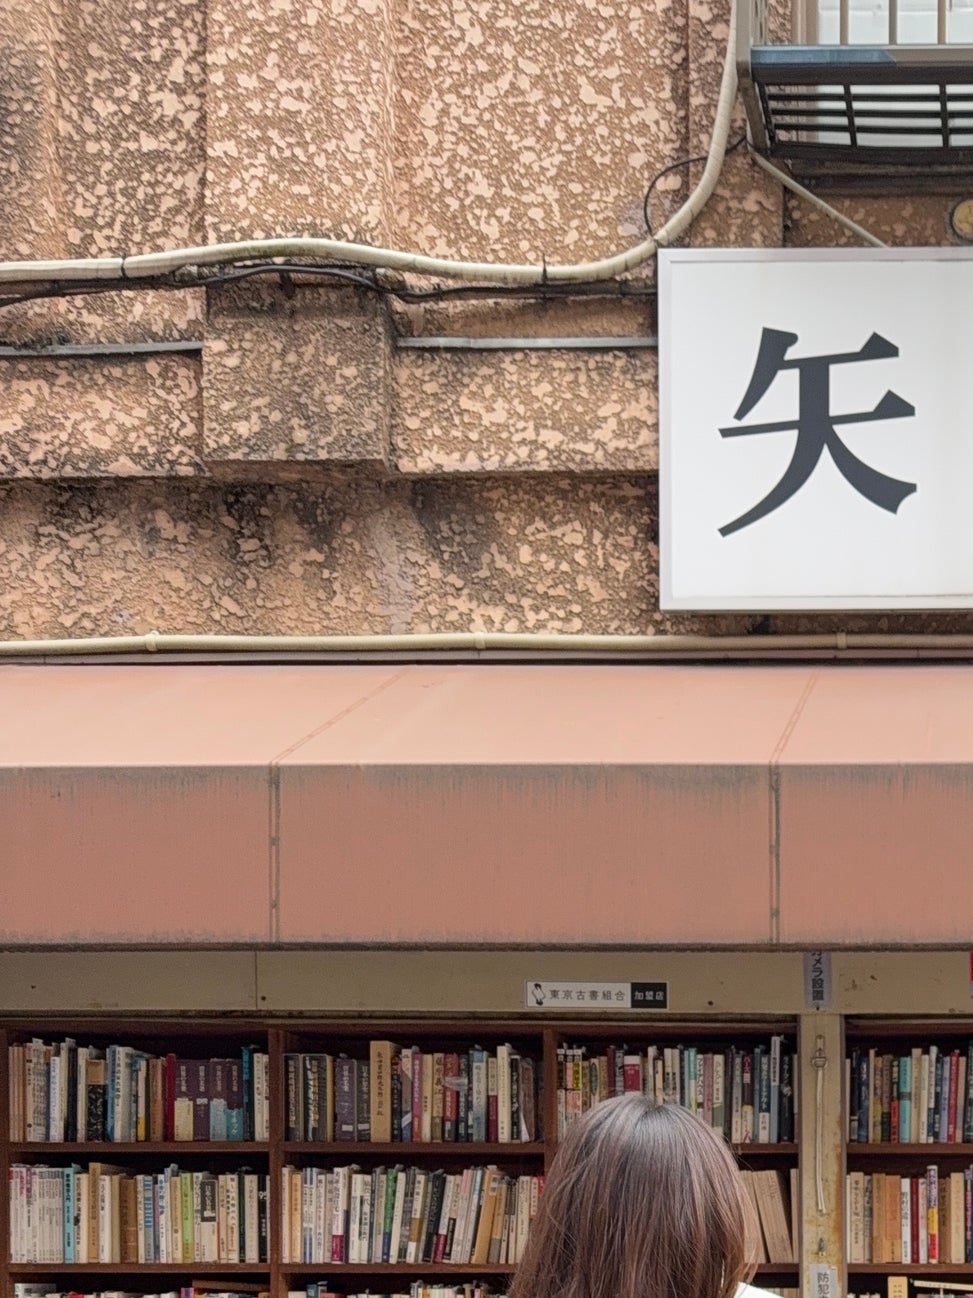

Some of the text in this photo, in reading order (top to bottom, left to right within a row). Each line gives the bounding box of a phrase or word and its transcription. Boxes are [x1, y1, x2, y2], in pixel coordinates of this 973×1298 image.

[549, 989, 664, 1001] 東京古書組合 加盟店
